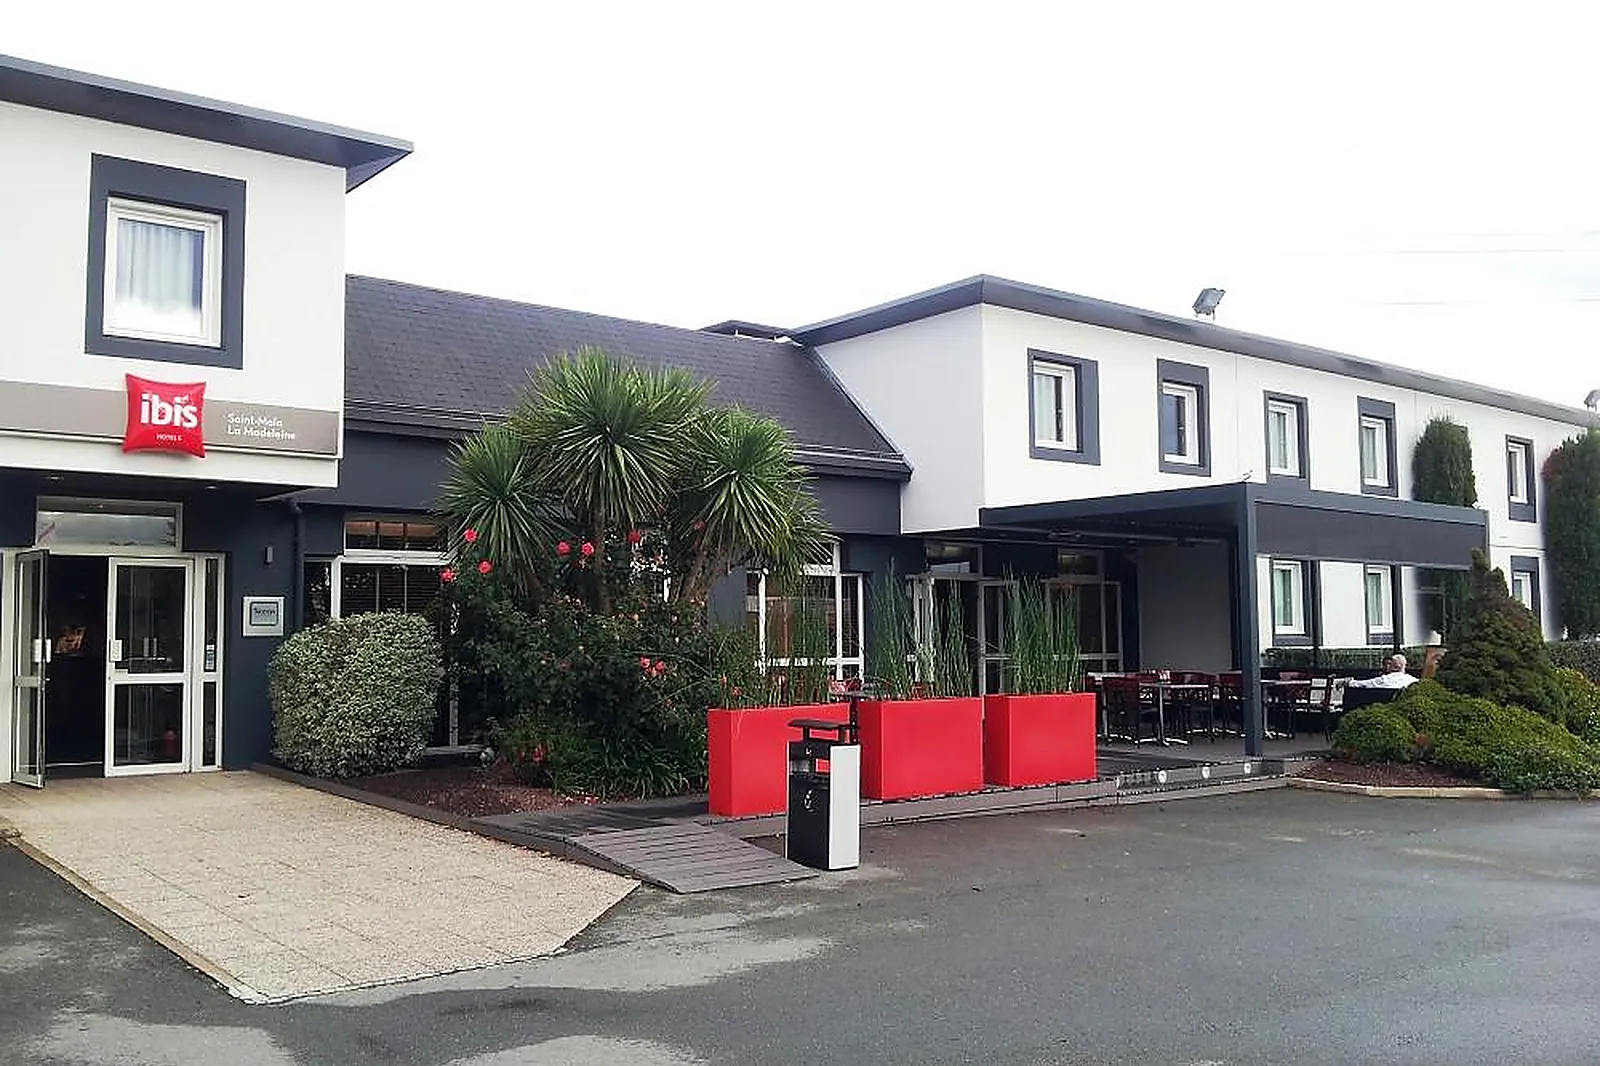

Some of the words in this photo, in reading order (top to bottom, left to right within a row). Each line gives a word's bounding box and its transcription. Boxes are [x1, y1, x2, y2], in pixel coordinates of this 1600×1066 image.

[140, 392, 198, 429] ibis
[227, 424, 241, 436] La
[243, 426, 296, 440] Madeleine
